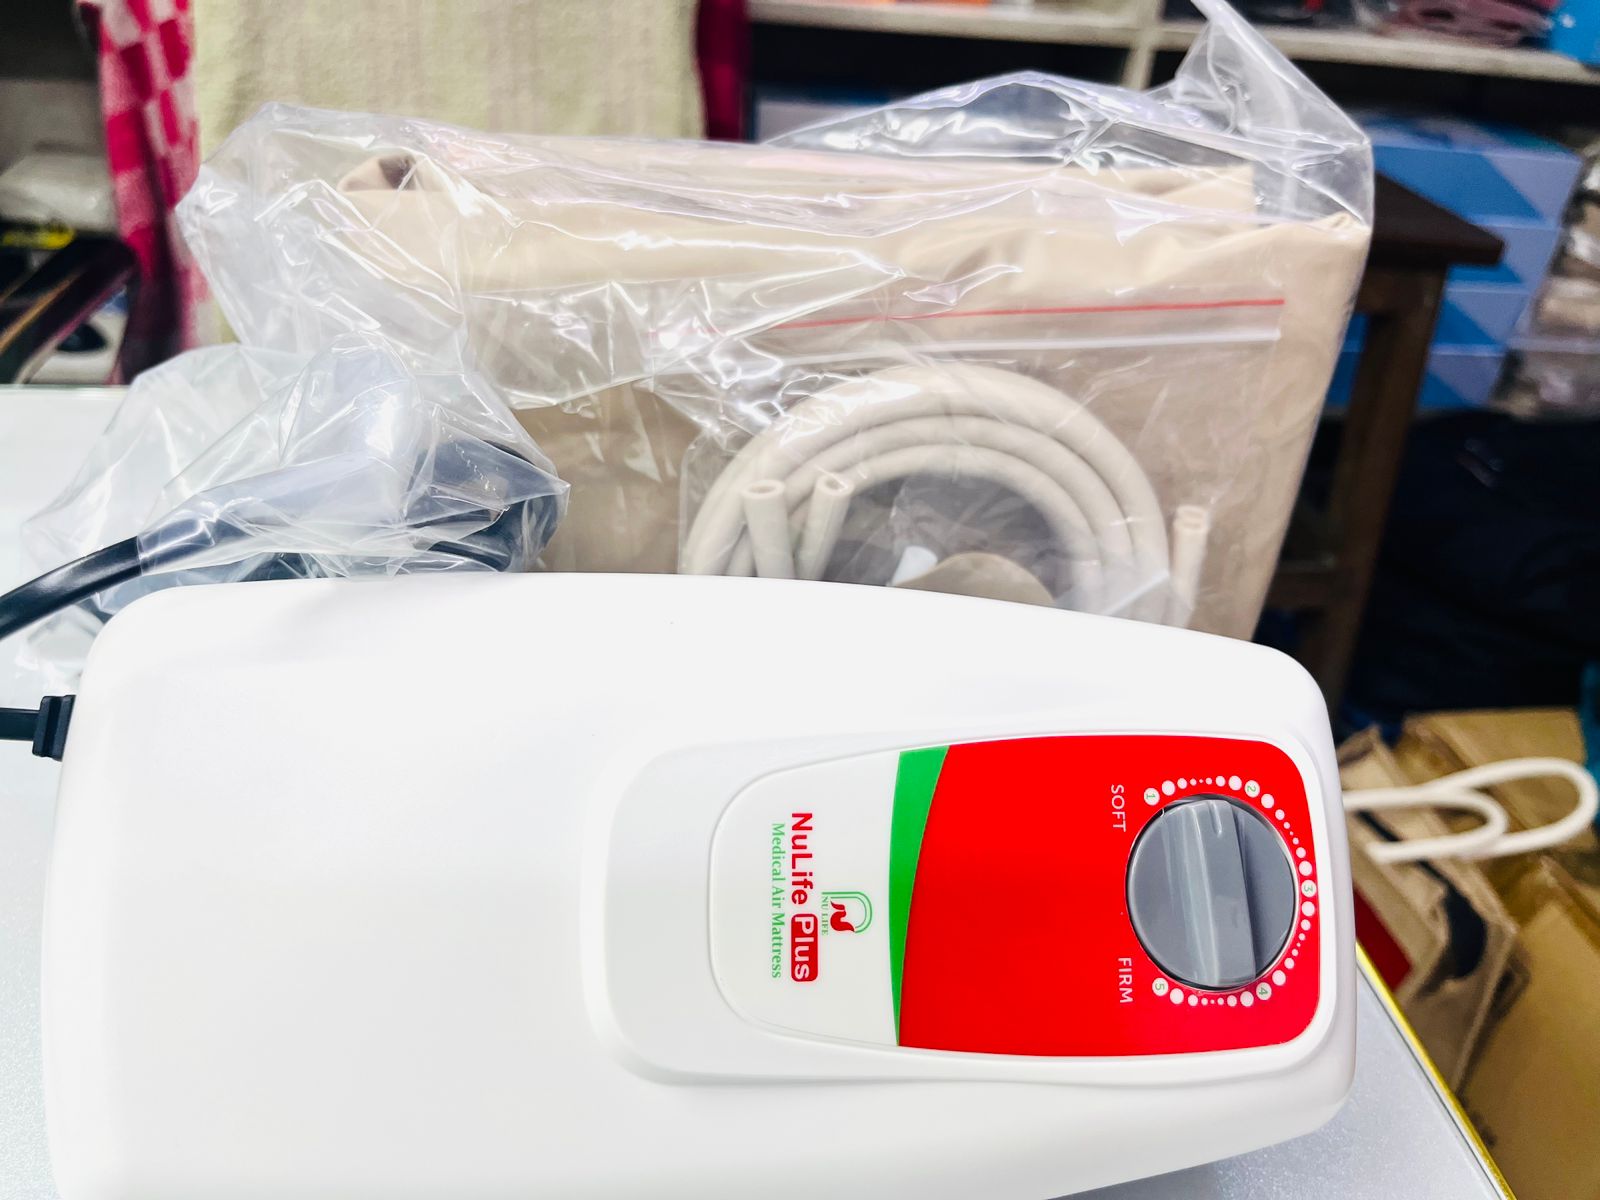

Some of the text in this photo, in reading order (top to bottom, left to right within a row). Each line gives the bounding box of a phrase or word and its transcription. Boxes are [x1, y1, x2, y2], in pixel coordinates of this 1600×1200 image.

[1111, 784, 1126, 832] SOFT
[772, 823, 785, 978] Medical Air Mattress
[792, 813, 814, 979] NuLife Plus
[821, 896, 828, 909] NU
[1118, 957, 1133, 1003] FIRM
